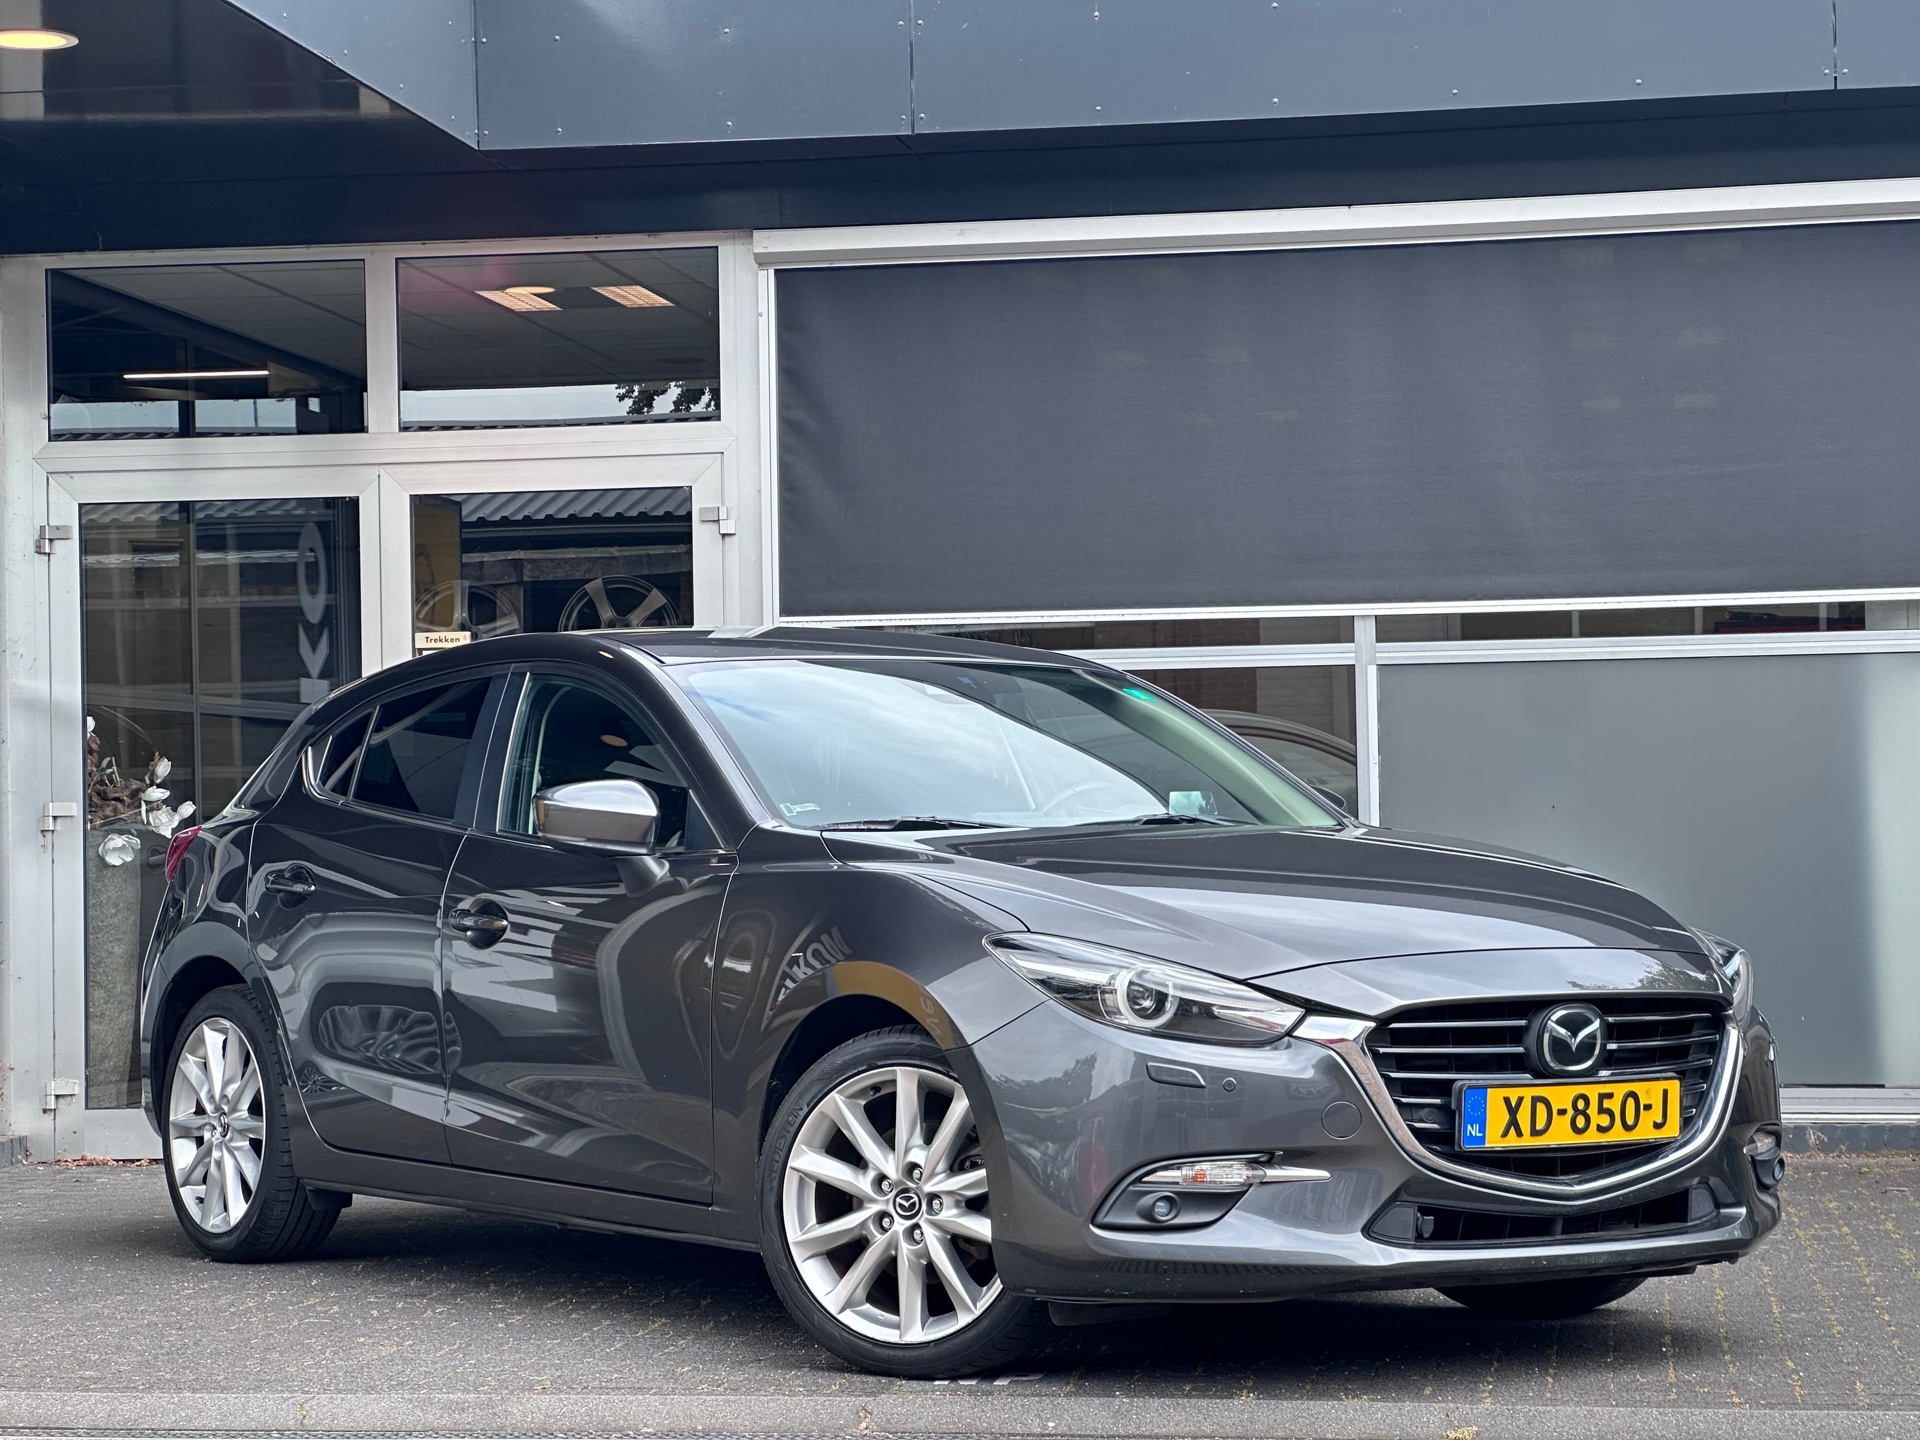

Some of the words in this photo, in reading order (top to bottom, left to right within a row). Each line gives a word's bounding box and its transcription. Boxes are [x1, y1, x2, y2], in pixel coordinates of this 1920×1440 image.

[425, 635, 460, 644] Trekken
[1500, 1088, 1669, 1139] XD-850-J
[1467, 1124, 1483, 1137] NL
